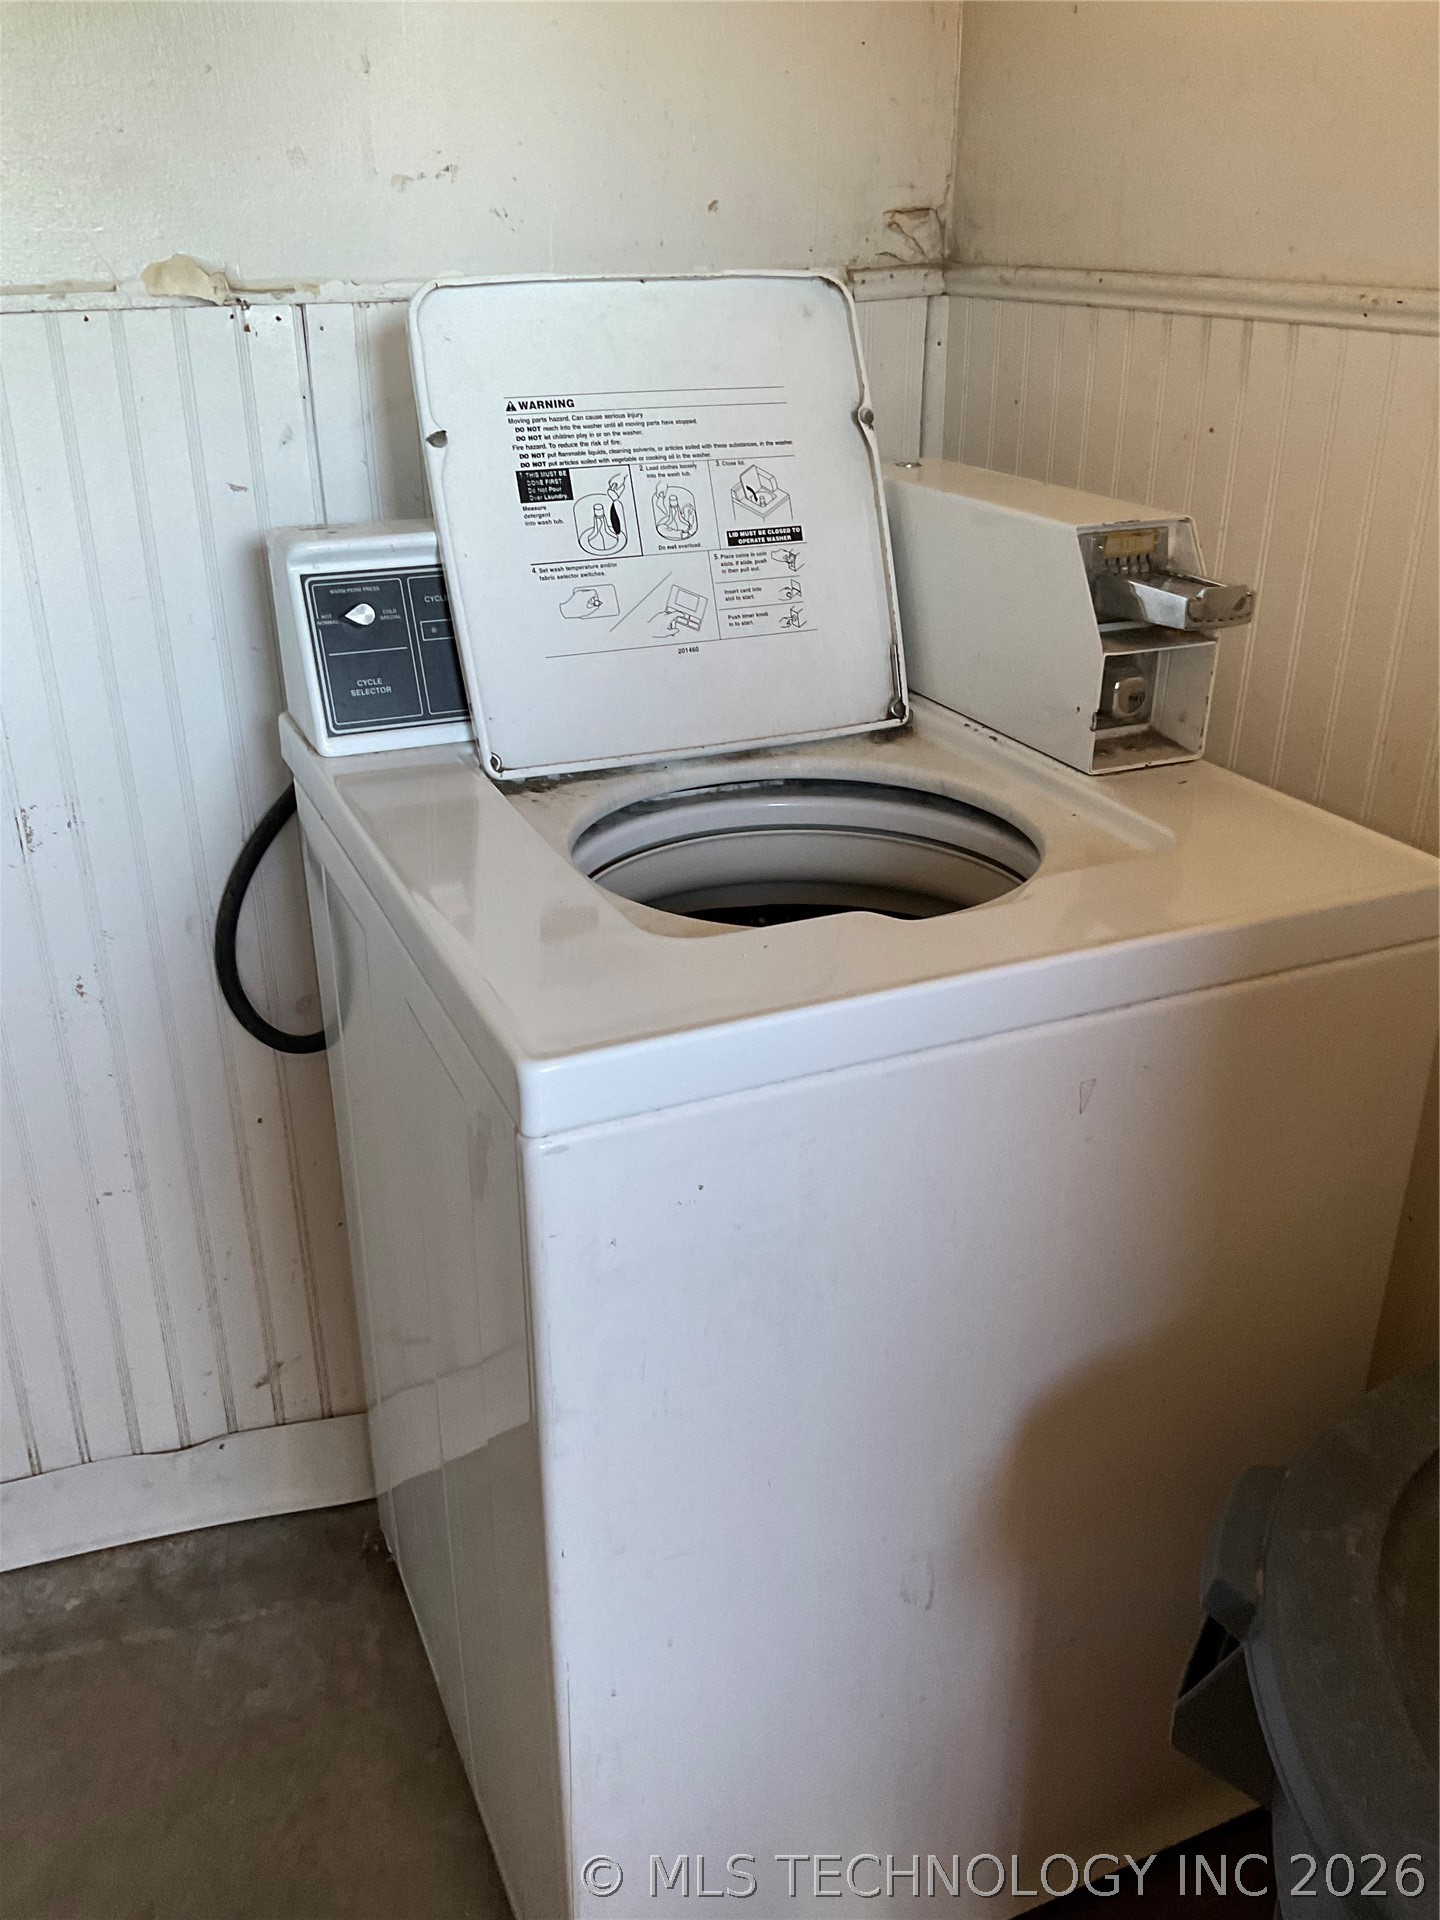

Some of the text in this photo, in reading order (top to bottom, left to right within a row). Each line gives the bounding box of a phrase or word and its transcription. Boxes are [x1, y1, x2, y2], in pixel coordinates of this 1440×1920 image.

[518, 399, 575, 410] WARNING
[357, 678, 382, 687] CYCLE
[351, 686, 392, 697] SELECTOR
